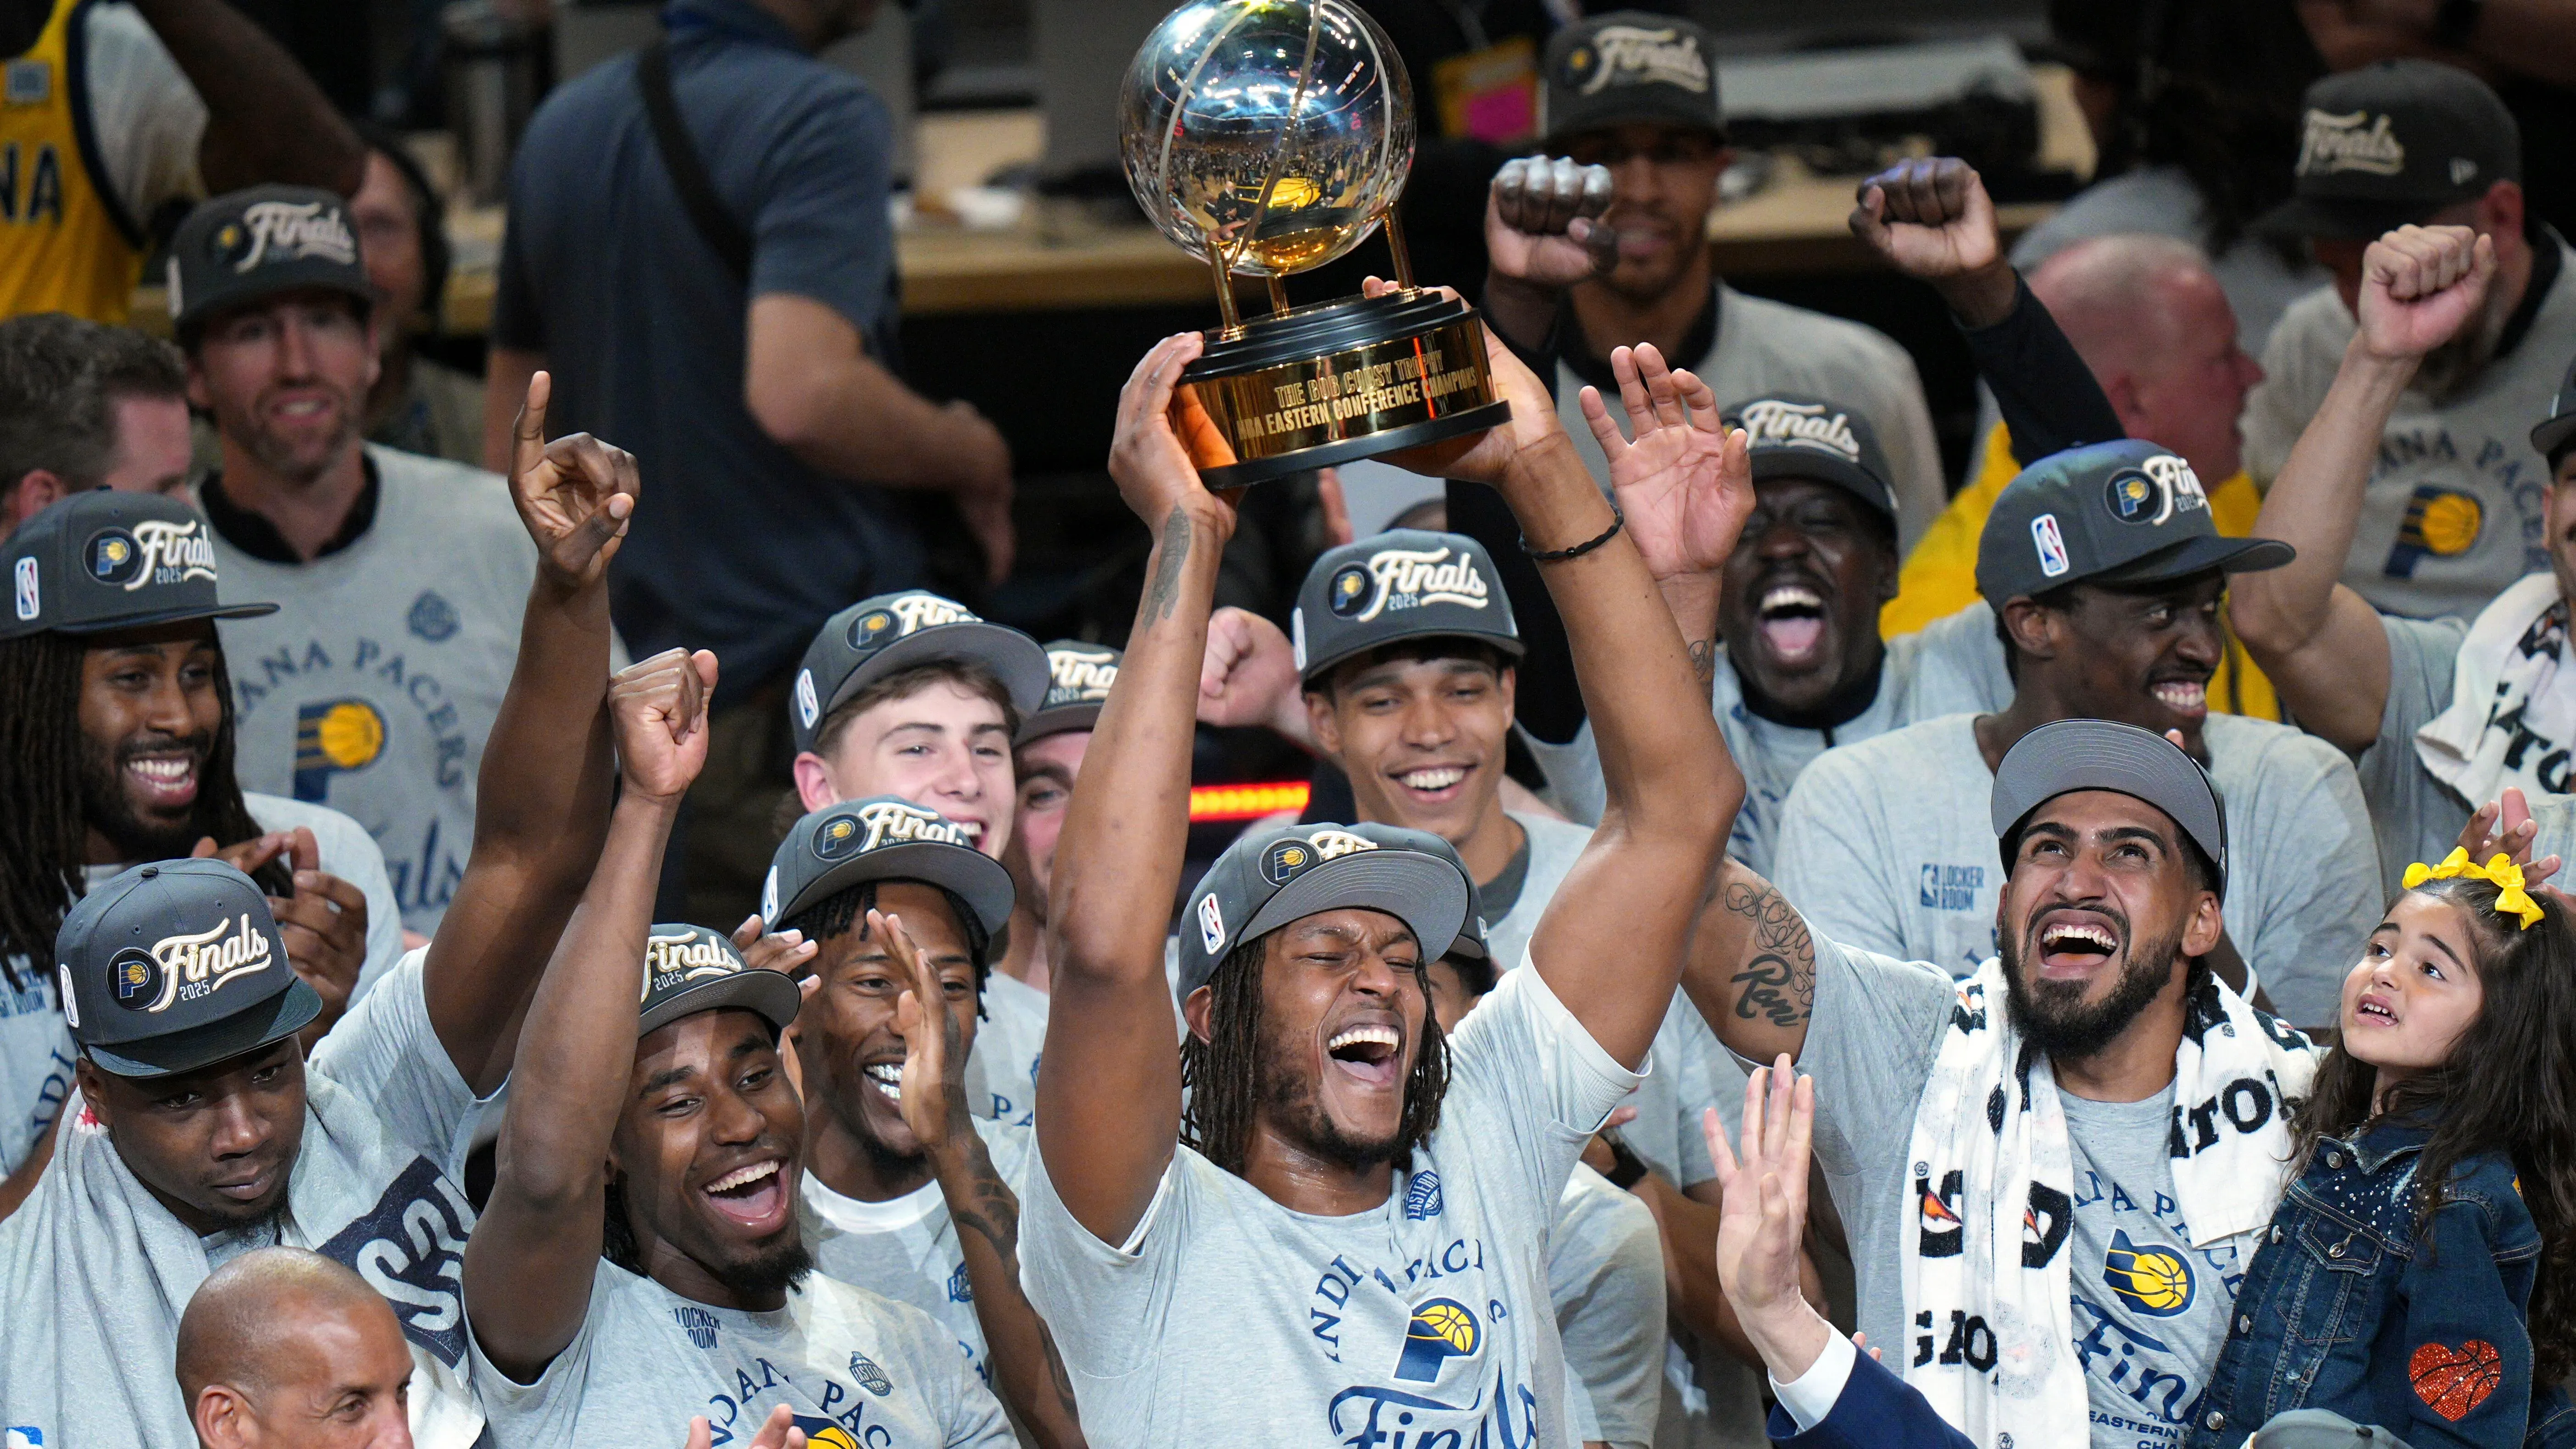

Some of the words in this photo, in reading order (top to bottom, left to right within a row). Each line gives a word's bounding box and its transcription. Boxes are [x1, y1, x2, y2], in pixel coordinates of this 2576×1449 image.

[1582, 26, 1709, 94] Finals
[2295, 108, 2404, 177] Finals
[233, 201, 356, 274] Finals
[1238, 416, 1265, 440] NBA
[1266, 403, 1330, 434] EASTERN
[1332, 386, 1420, 421] CONFERENCE
[1422, 367, 1477, 399] CHAMPIONS
[1275, 385, 1305, 409] THE
[1308, 377, 1341, 400] BOB
[1343, 363, 1393, 394] COUSY
[1394, 350, 1443, 380] TROPHY
[1742, 400, 1860, 463] Finals
[1358, 547, 1489, 622] Finals
[1388, 591, 1419, 611] 2025
[148, 913, 272, 1013] Finals
[179, 980, 211, 1001] 2025
[653, 970, 684, 992] 2025
[688, 1327, 717, 1349] OOM
[2089, 1410, 2178, 1439] EASTERN
